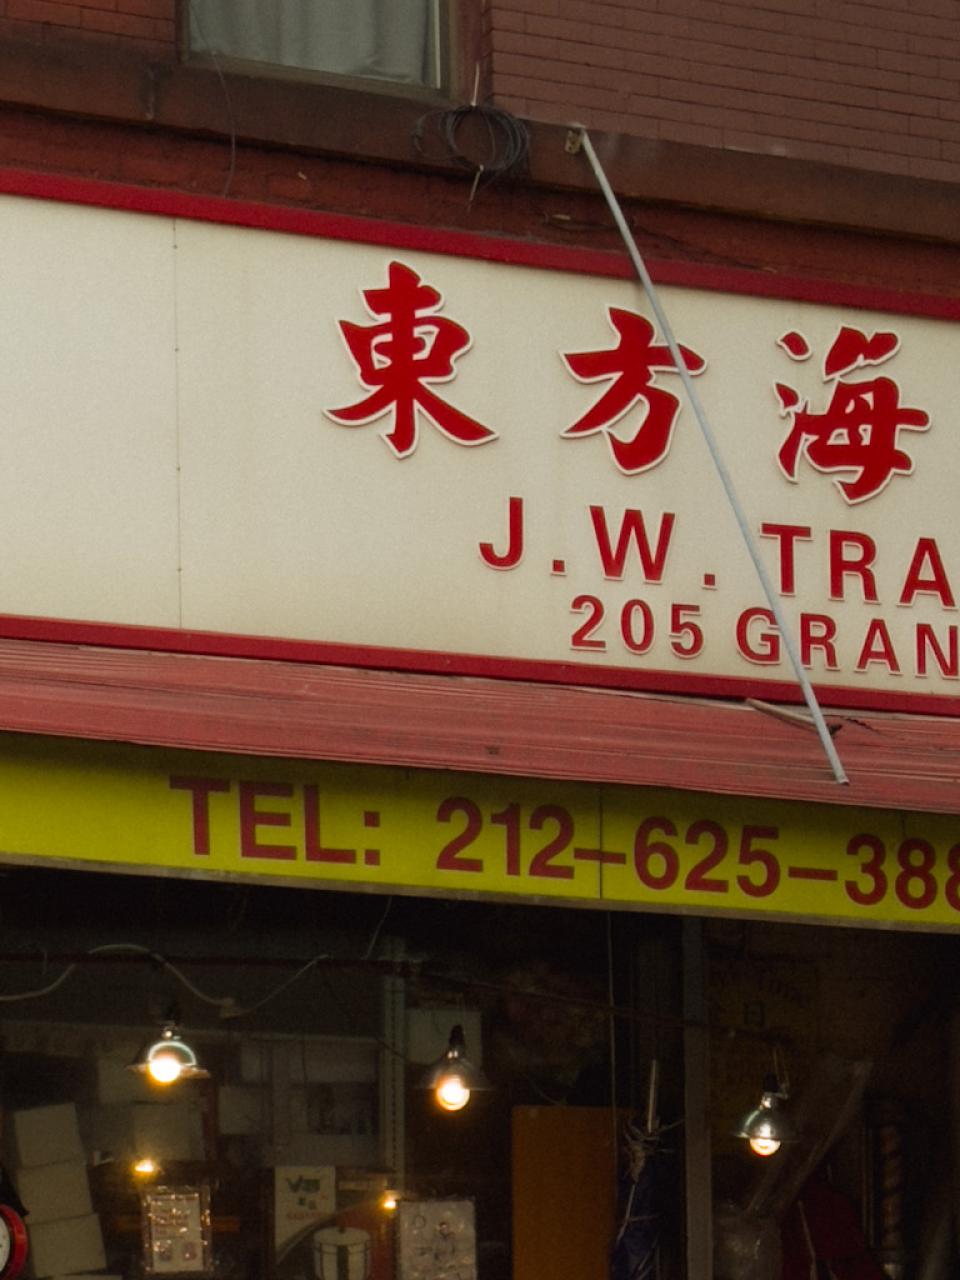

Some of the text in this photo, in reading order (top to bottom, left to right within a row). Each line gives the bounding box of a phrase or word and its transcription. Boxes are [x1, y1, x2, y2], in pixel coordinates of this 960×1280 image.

[478, 495, 718, 589] J.W.
[568, 594, 706, 659] 205
[168, 774, 382, 867] TEL:
